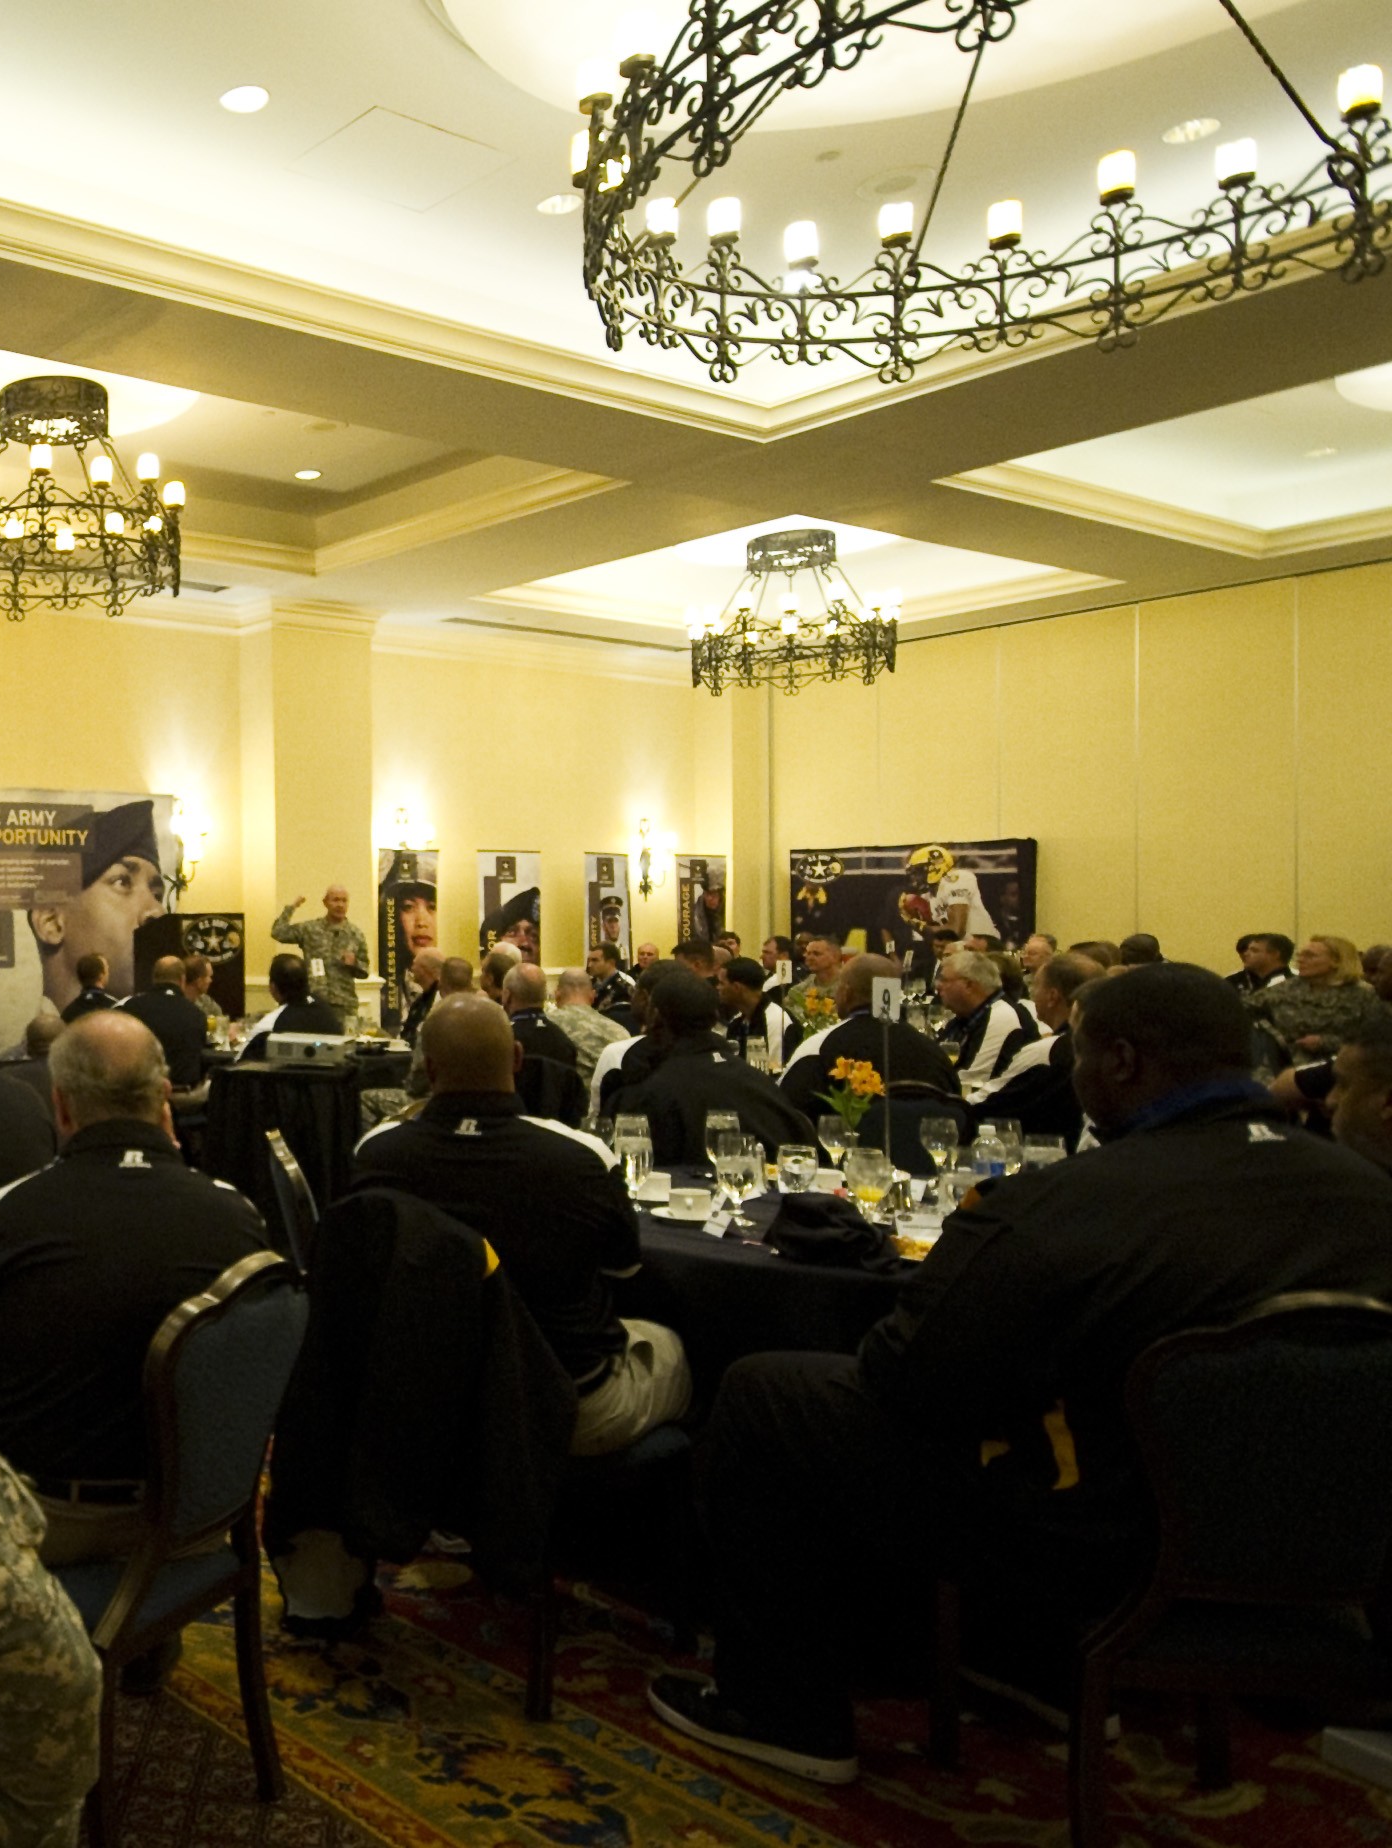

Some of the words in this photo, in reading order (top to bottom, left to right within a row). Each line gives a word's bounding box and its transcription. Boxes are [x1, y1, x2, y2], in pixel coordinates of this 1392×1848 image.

[7, 808, 57, 827] ARMY
[387, 897, 397, 947] SERVICE
[387, 951, 399, 1009] SELFLESS
